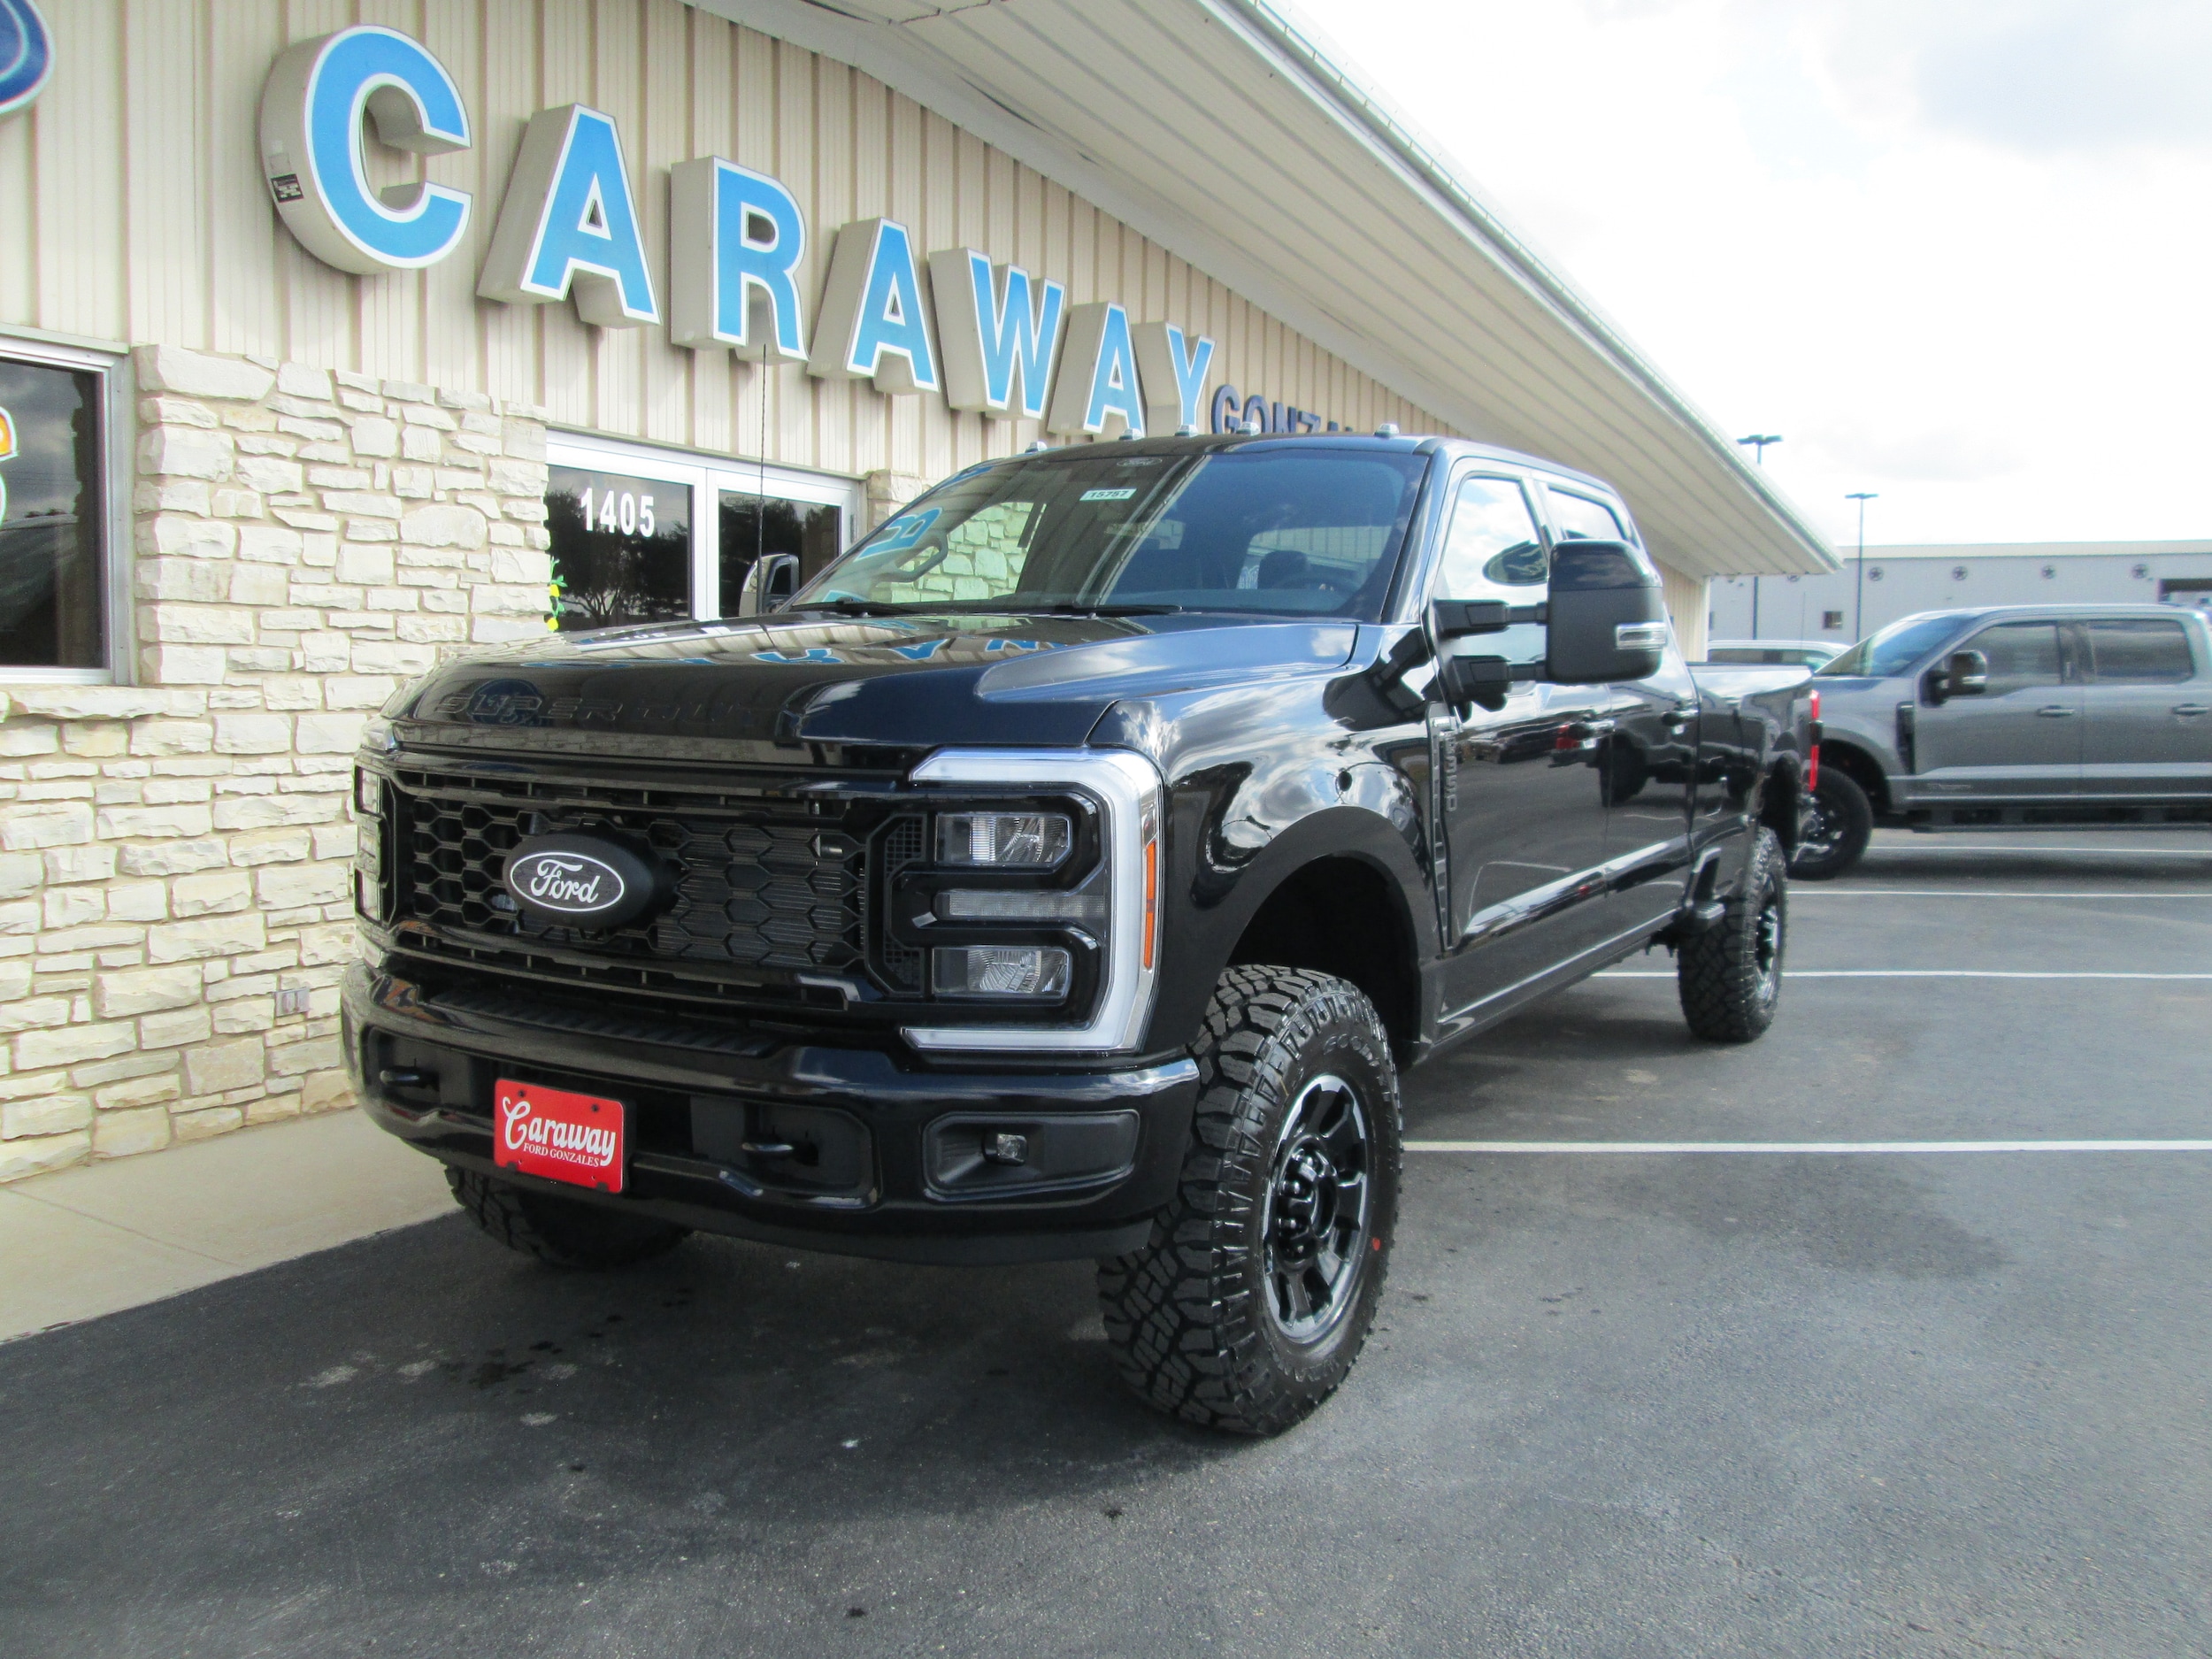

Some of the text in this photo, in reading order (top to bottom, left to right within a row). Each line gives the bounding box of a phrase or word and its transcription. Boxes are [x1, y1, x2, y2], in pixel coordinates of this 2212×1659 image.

[305, 24, 1216, 435] CARAWAY
[581, 488, 655, 538] 1405
[531, 858, 601, 903] Ford
[502, 1096, 617, 1167] Caraway
[523, 1142, 600, 1167] FORD GONZALES
